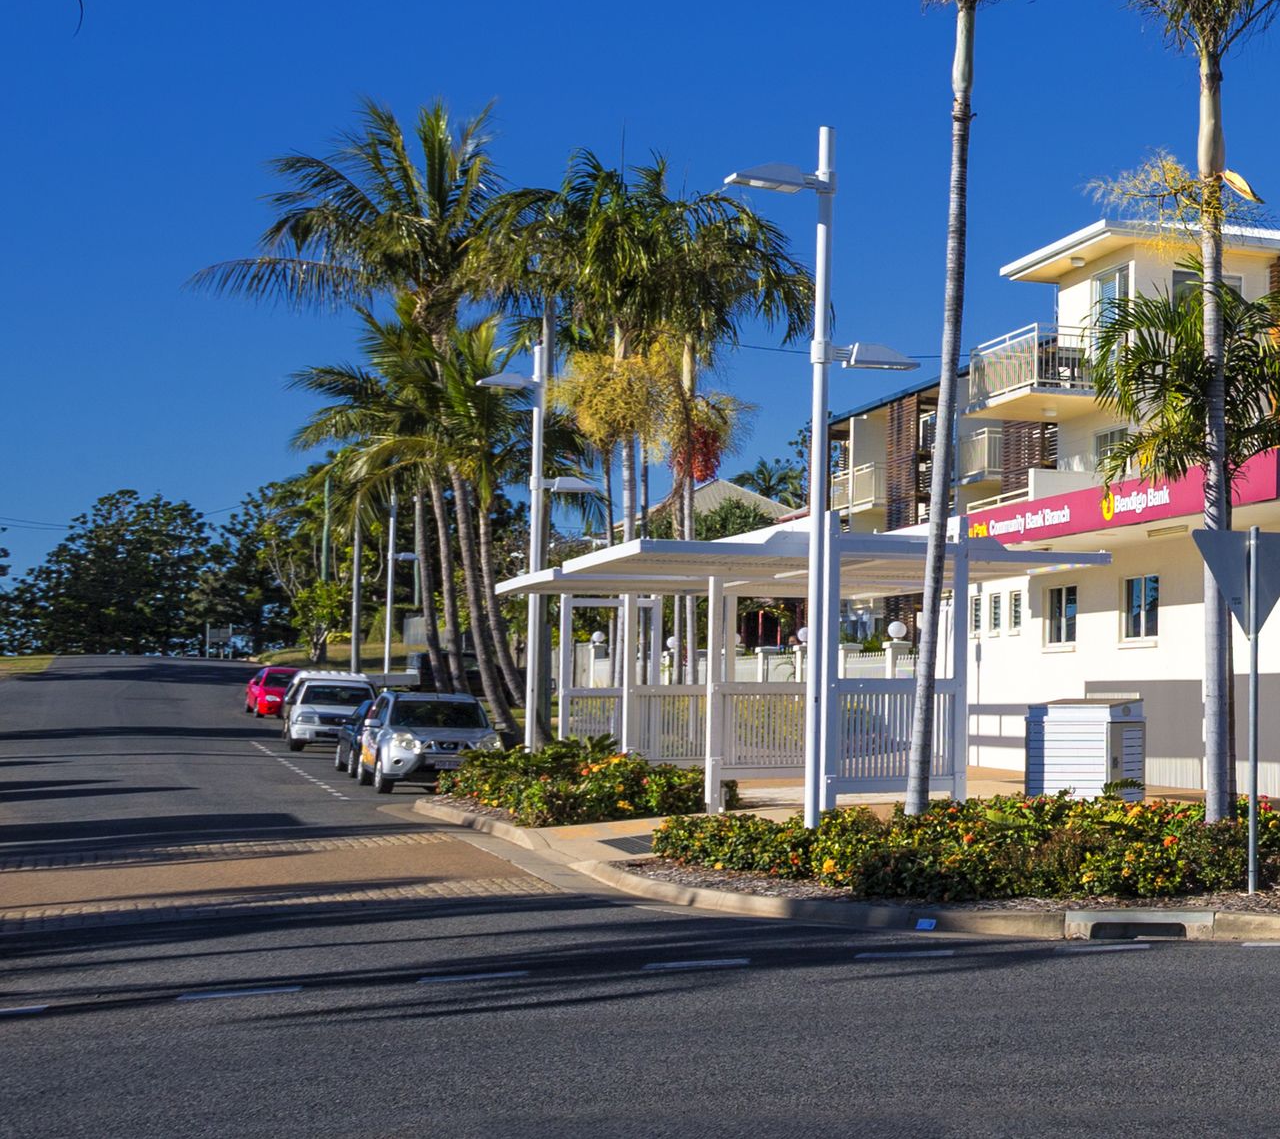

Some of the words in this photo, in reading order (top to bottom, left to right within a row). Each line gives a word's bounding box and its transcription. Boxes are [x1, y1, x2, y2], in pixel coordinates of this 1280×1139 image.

[1114, 492, 1147, 513] Bendigo
[1147, 486, 1170, 508] Bank
[989, 514, 1025, 536] Community
[1025, 510, 1044, 530] Bank
[1044, 504, 1070, 525] Branch
